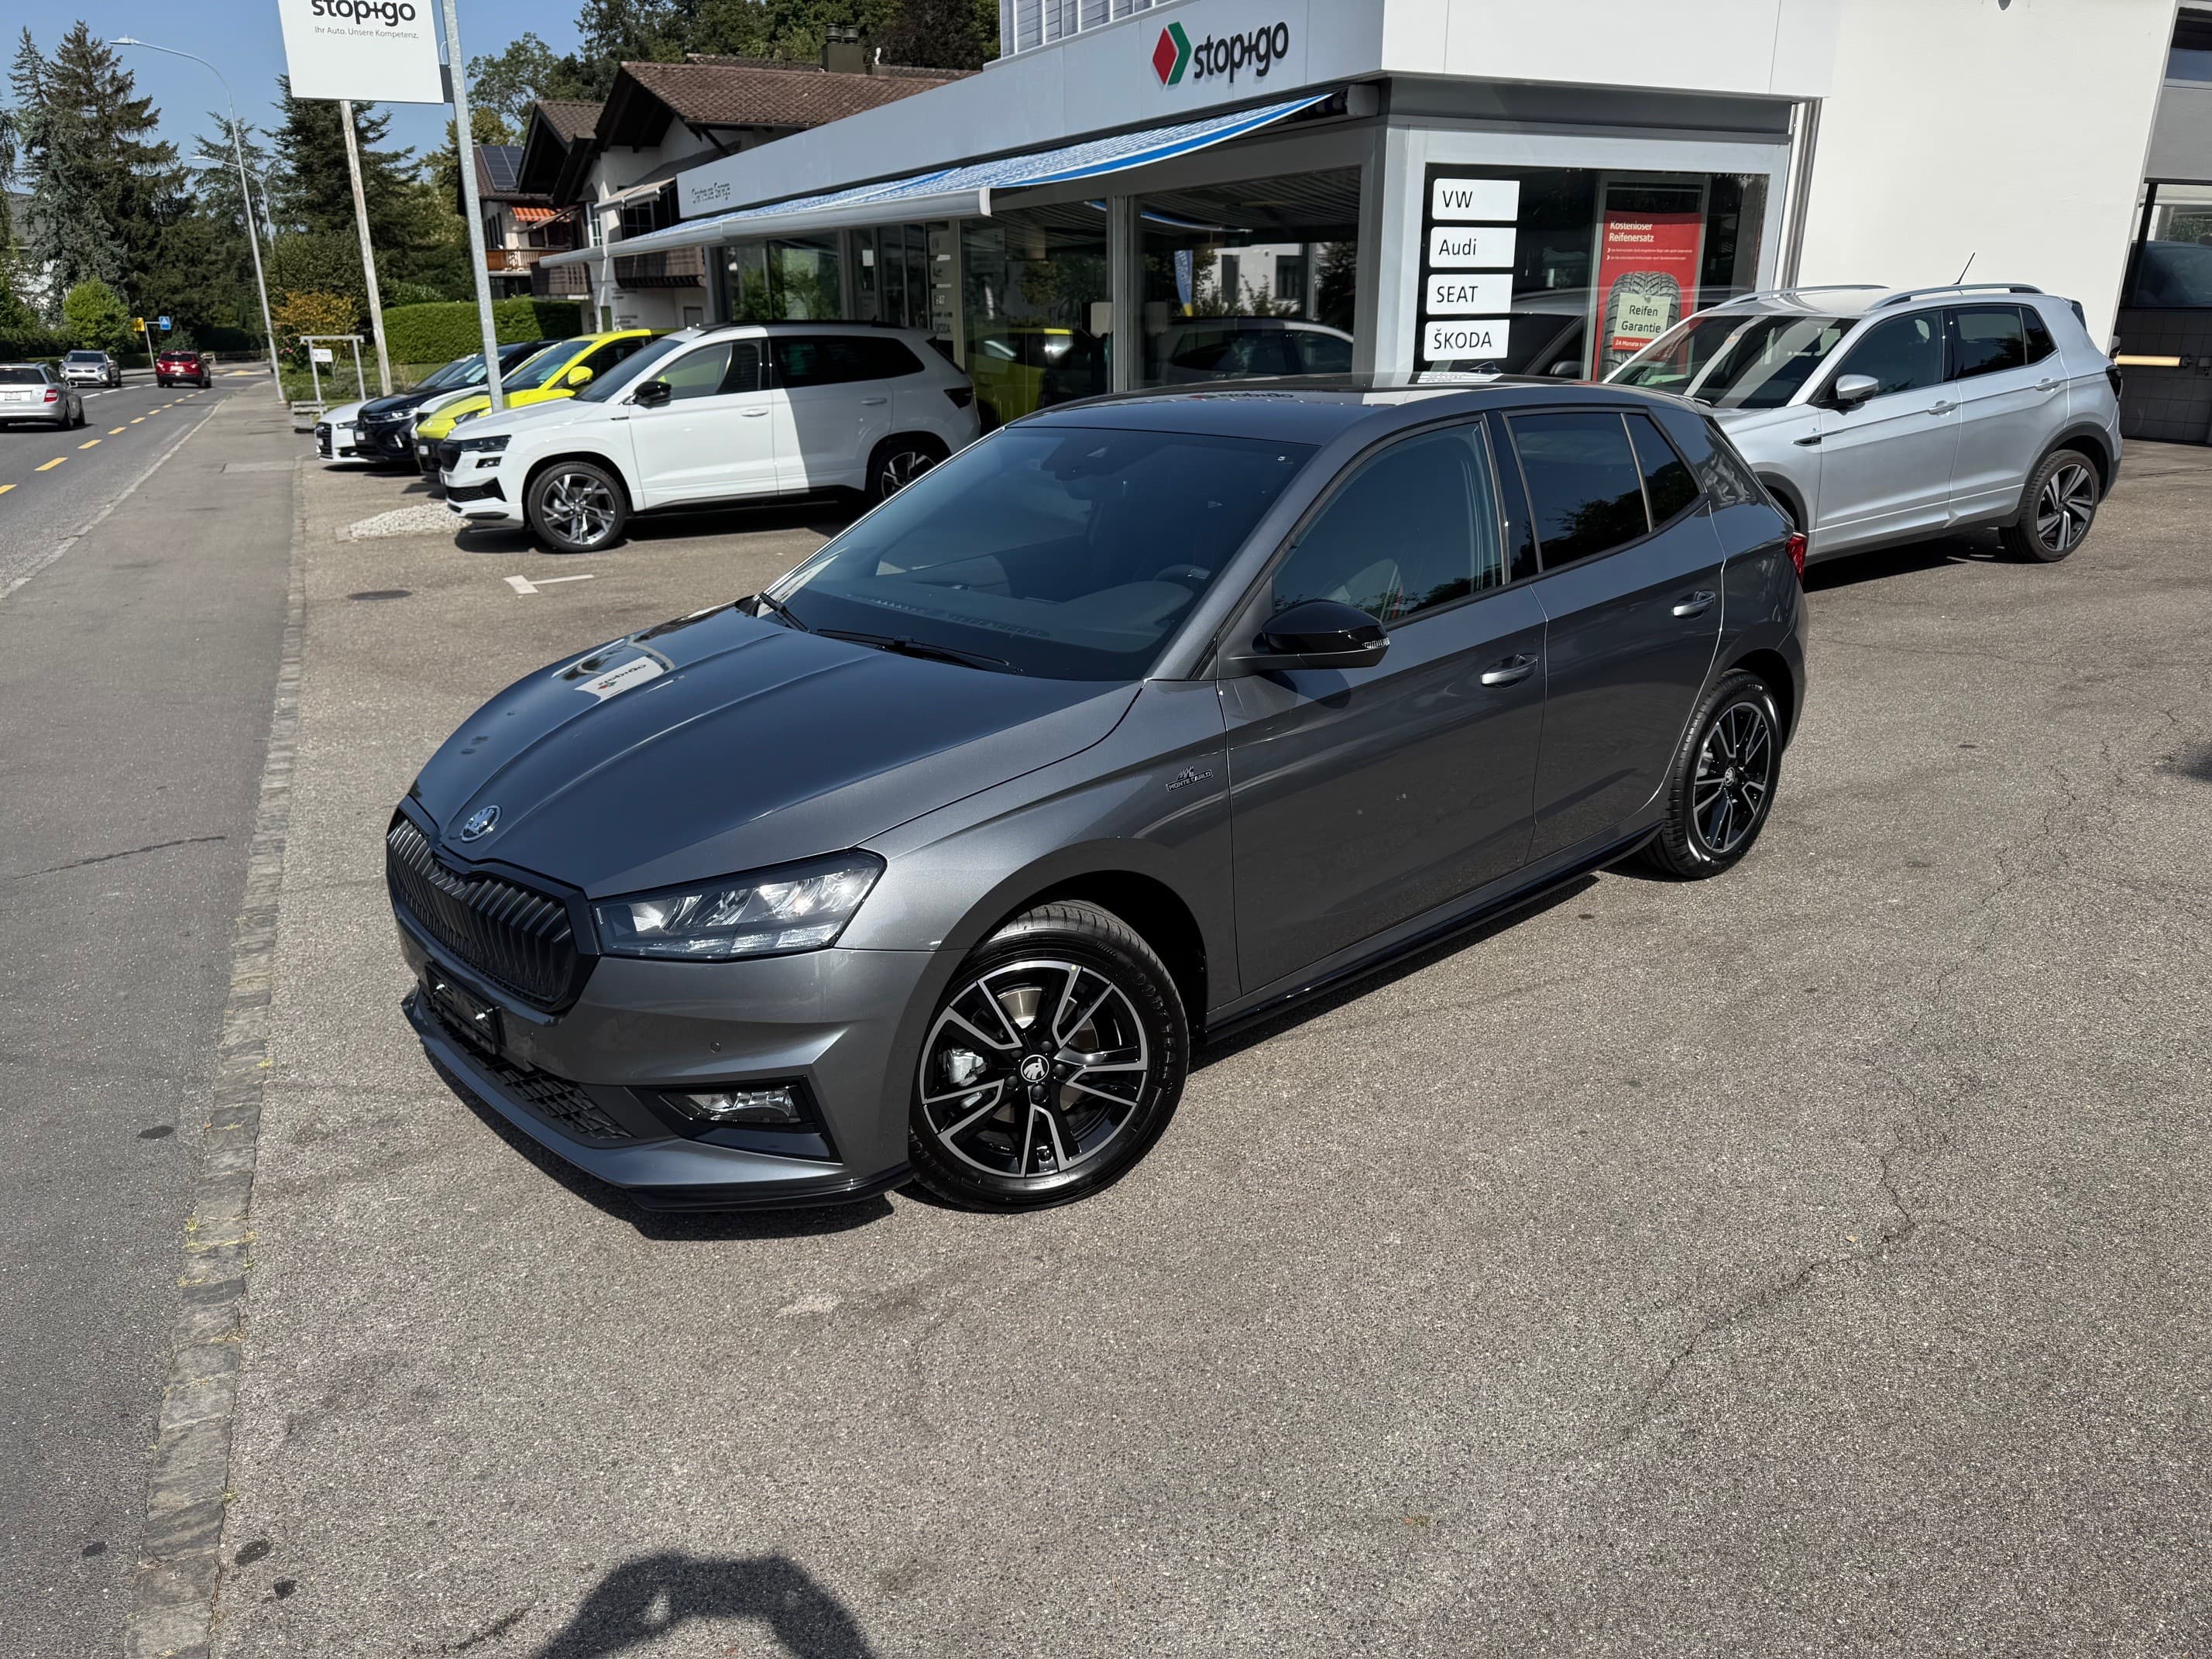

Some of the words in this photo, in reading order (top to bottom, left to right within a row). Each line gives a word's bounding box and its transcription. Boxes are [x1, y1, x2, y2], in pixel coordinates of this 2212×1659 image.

[312, 0, 415, 26] stop+go
[376, 29, 419, 39] Kompetenz.
[1194, 22, 1289, 83] stop+go
[1442, 191, 1473, 208] VW
[1610, 221, 1653, 230] Kostenloser
[1609, 232, 1654, 242] Reifenersatz
[1439, 238, 1477, 256] Audi
[1436, 286, 1479, 303] SEAT
[1629, 304, 1658, 317] Reifen
[1621, 321, 1661, 333] Garantie
[1434, 328, 1492, 349] ŠKODA
[1168, 778, 1190, 791] MONTE
[1190, 771, 1211, 782] CARLO
